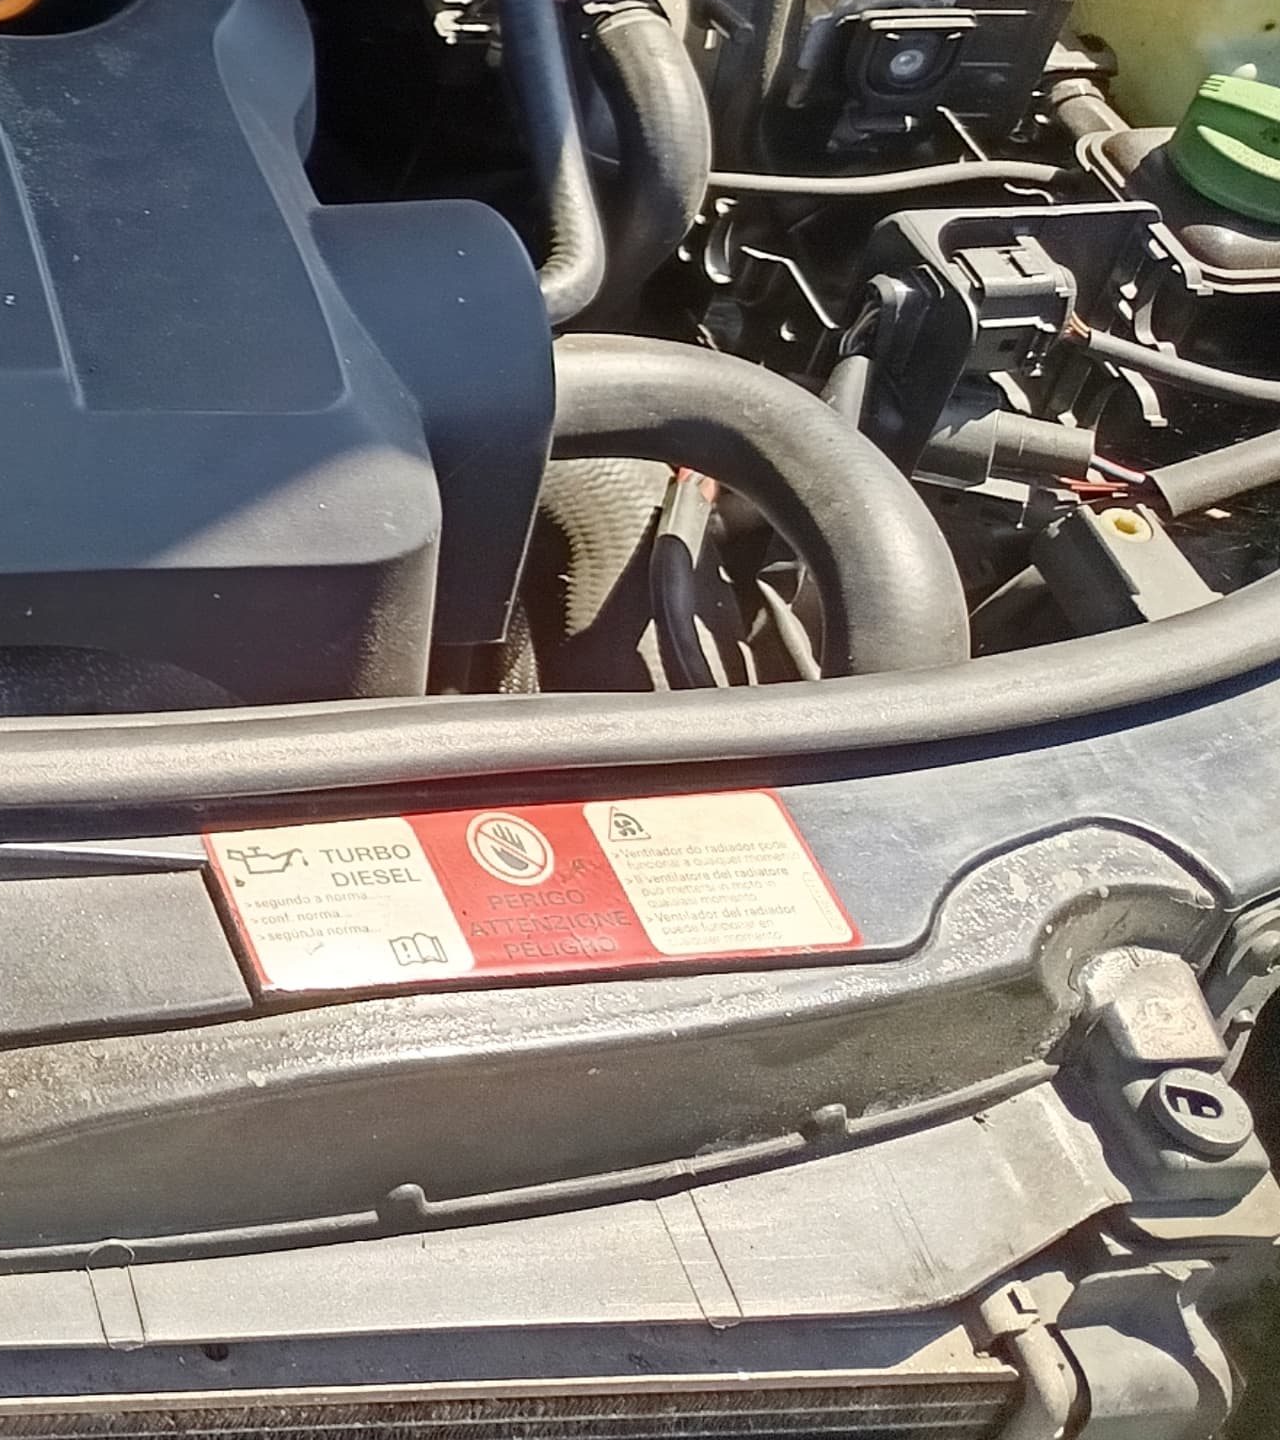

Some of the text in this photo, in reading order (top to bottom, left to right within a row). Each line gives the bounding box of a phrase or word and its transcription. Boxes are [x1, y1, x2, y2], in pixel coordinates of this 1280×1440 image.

[318, 843, 412, 865] TURBO
[619, 846, 684, 859] Ventilador
[705, 841, 755, 853] radiador
[331, 867, 422, 888] DIESEL
[713, 868, 733, 880] del
[734, 866, 790, 878] radiatore
[487, 889, 586, 911] PERIGO
[470, 910, 633, 937] ATTENZIONE
[654, 910, 718, 923] Ventilador
[723, 907, 742, 919] del
[503, 936, 618, 960] PELIGRO
